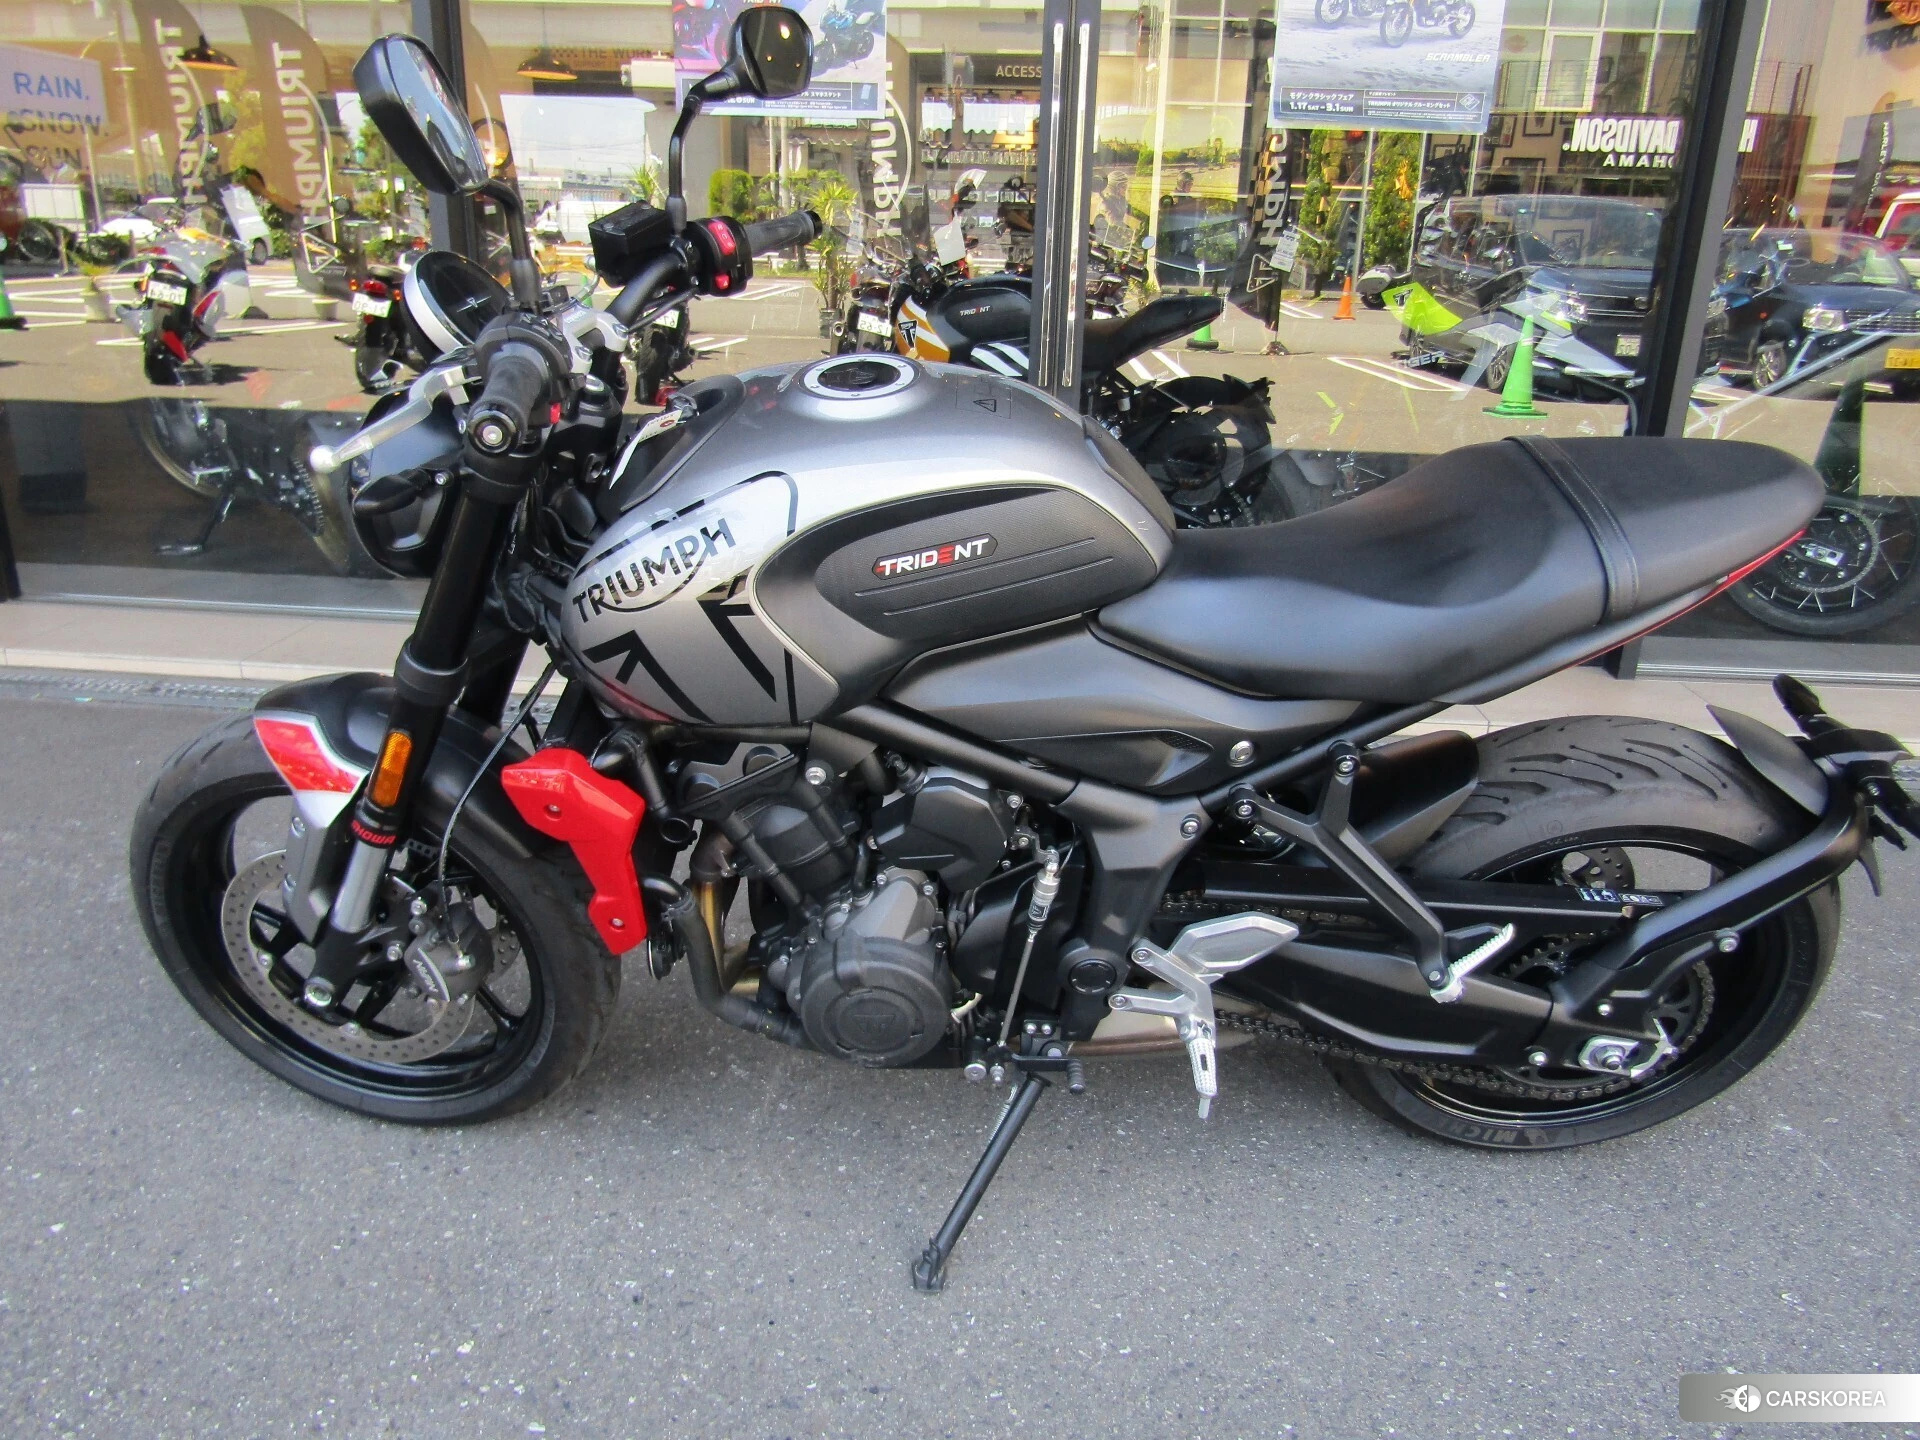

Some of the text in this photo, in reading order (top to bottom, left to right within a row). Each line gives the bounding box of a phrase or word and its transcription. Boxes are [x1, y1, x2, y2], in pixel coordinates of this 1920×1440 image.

[1425, 52, 1490, 63] SCRAMBLER
[13, 72, 89, 101] RAIN.
[1289, 92, 1354, 101] モダンクラシックフェア
[572, 517, 736, 623] TRIUMPH
[877, 538, 989, 577] TRIDENT
